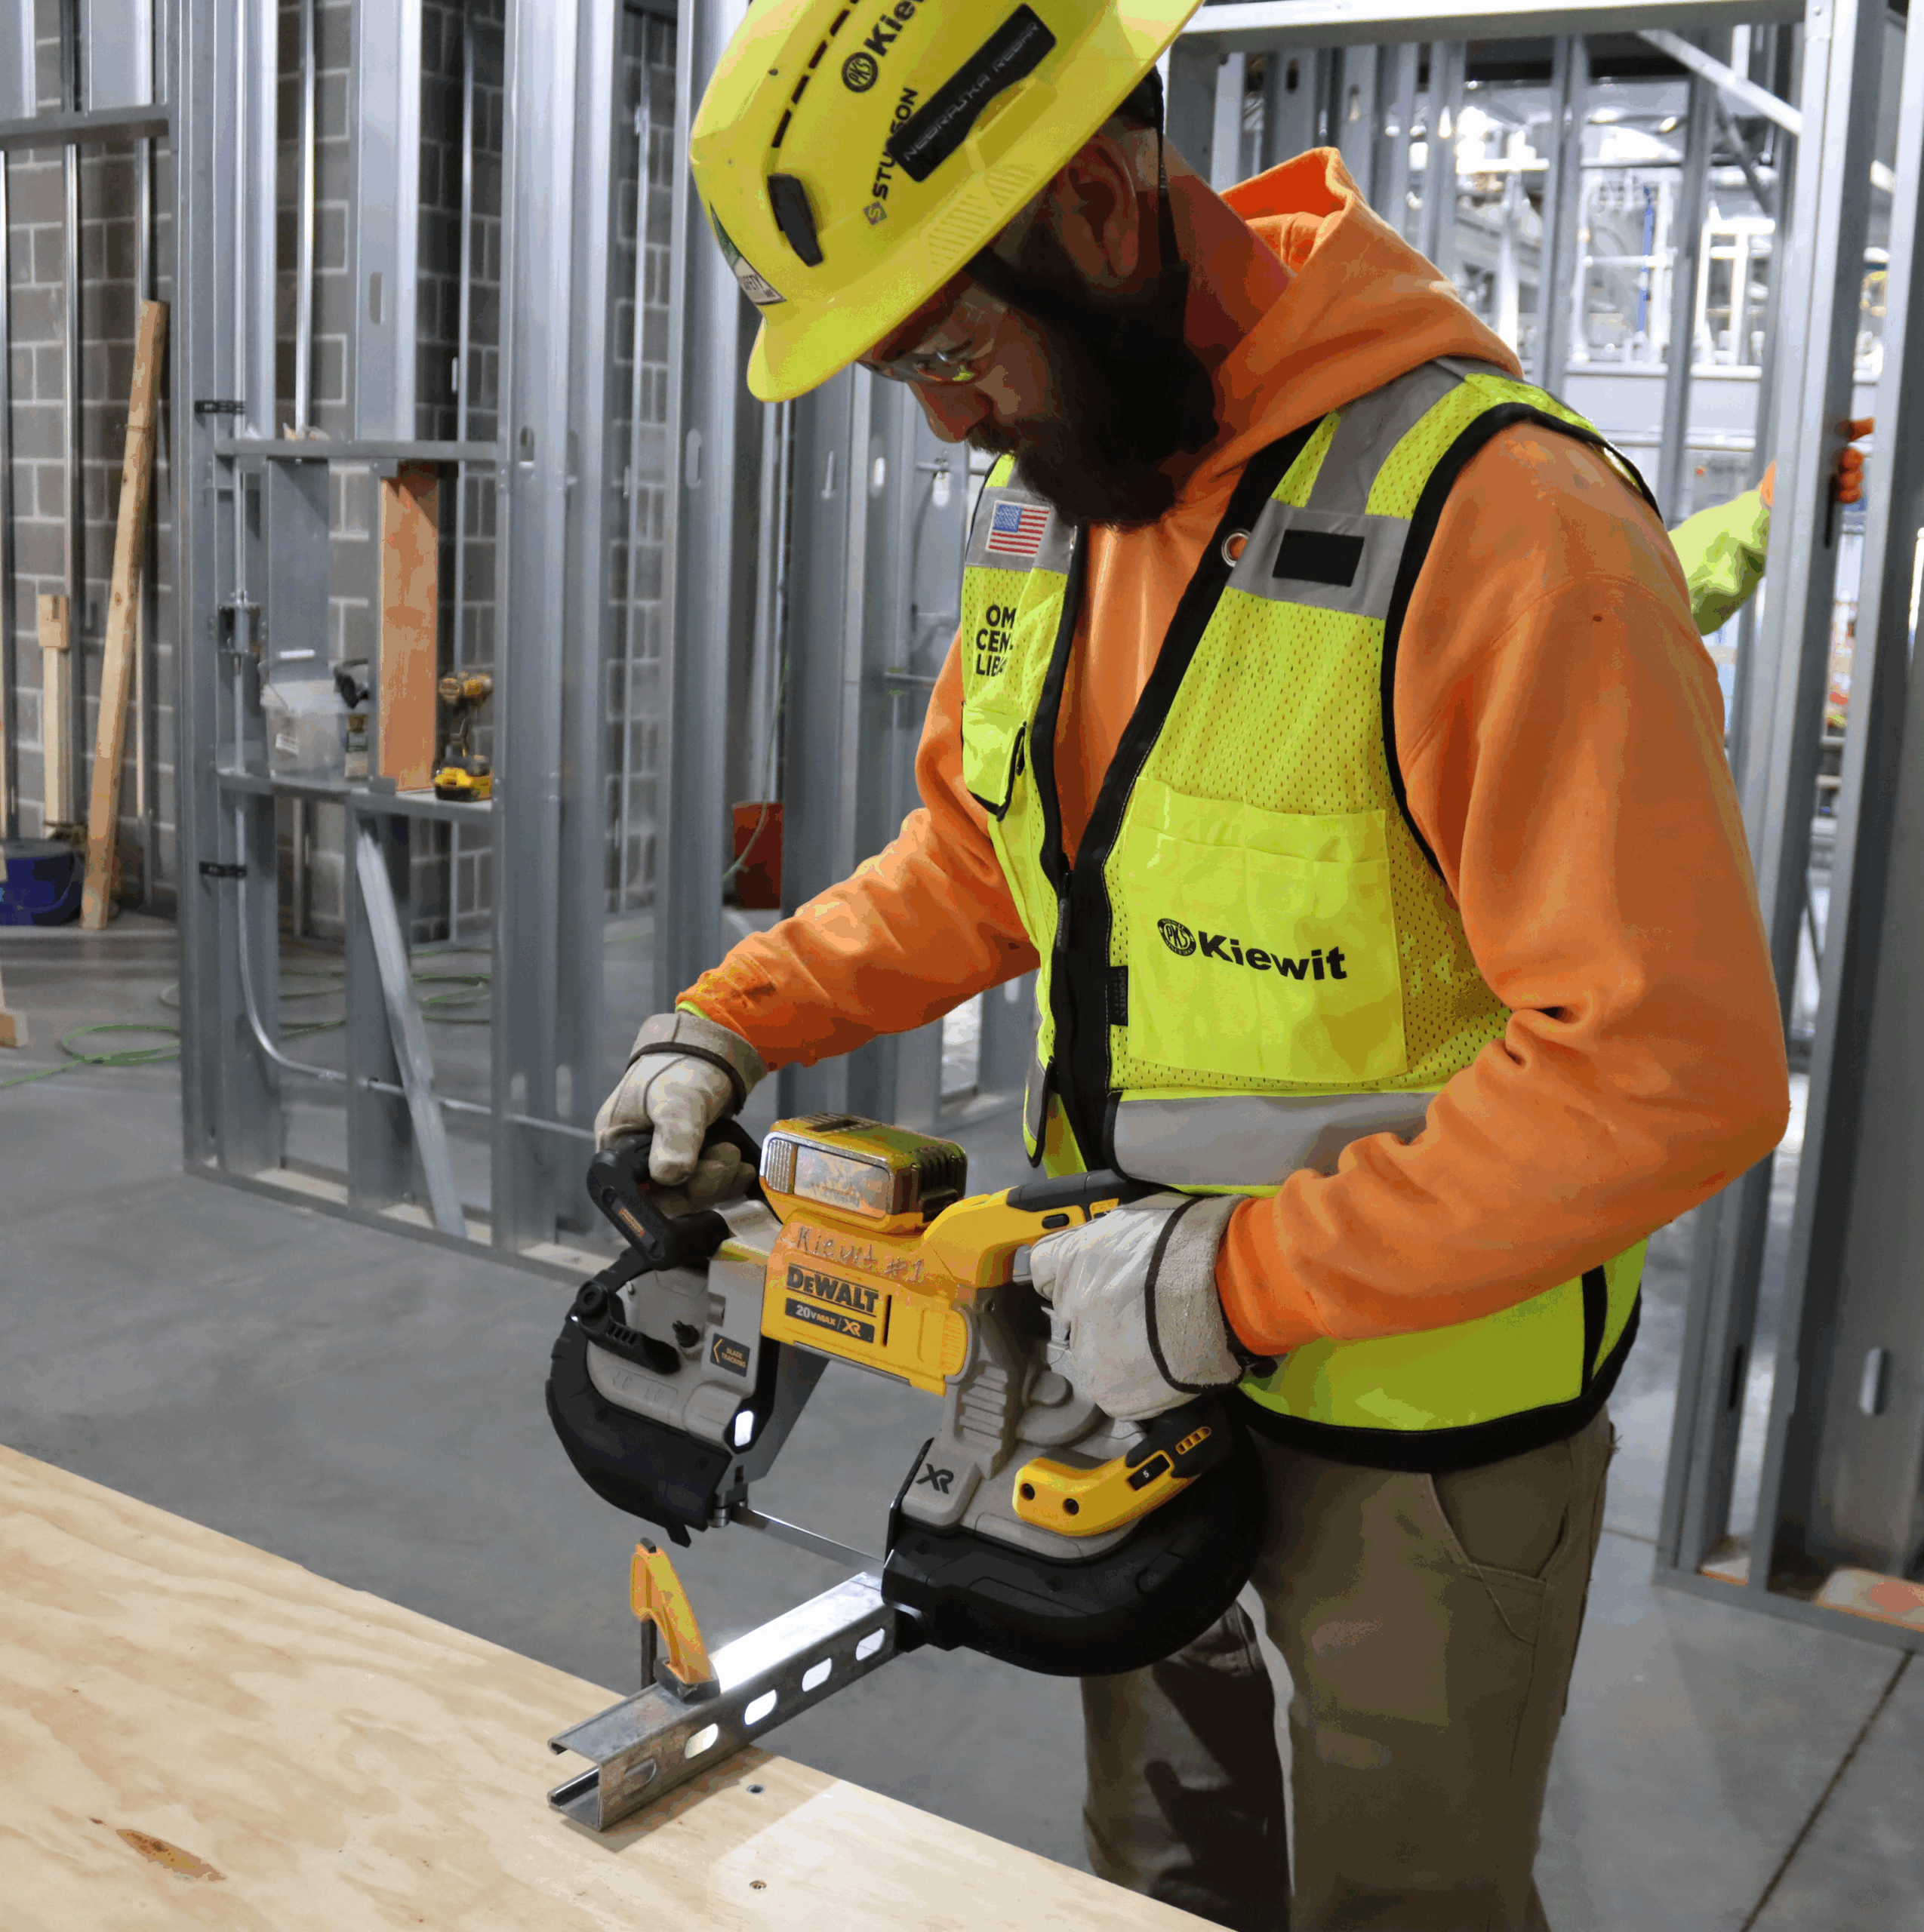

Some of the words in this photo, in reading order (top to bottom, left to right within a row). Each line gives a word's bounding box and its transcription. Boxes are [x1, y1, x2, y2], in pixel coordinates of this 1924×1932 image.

[863, 0, 925, 57] Kie
[992, 21, 1039, 72] REBAR
[873, 87, 919, 201] STUSON
[976, 629, 1013, 653] CEN
[1198, 931, 1347, 980] Kiewit
[787, 1265, 879, 1313] DEWALT
[884, 1256, 925, 1284] #1
[842, 1318, 860, 1337] XR
[916, 1463, 954, 1494] XR
